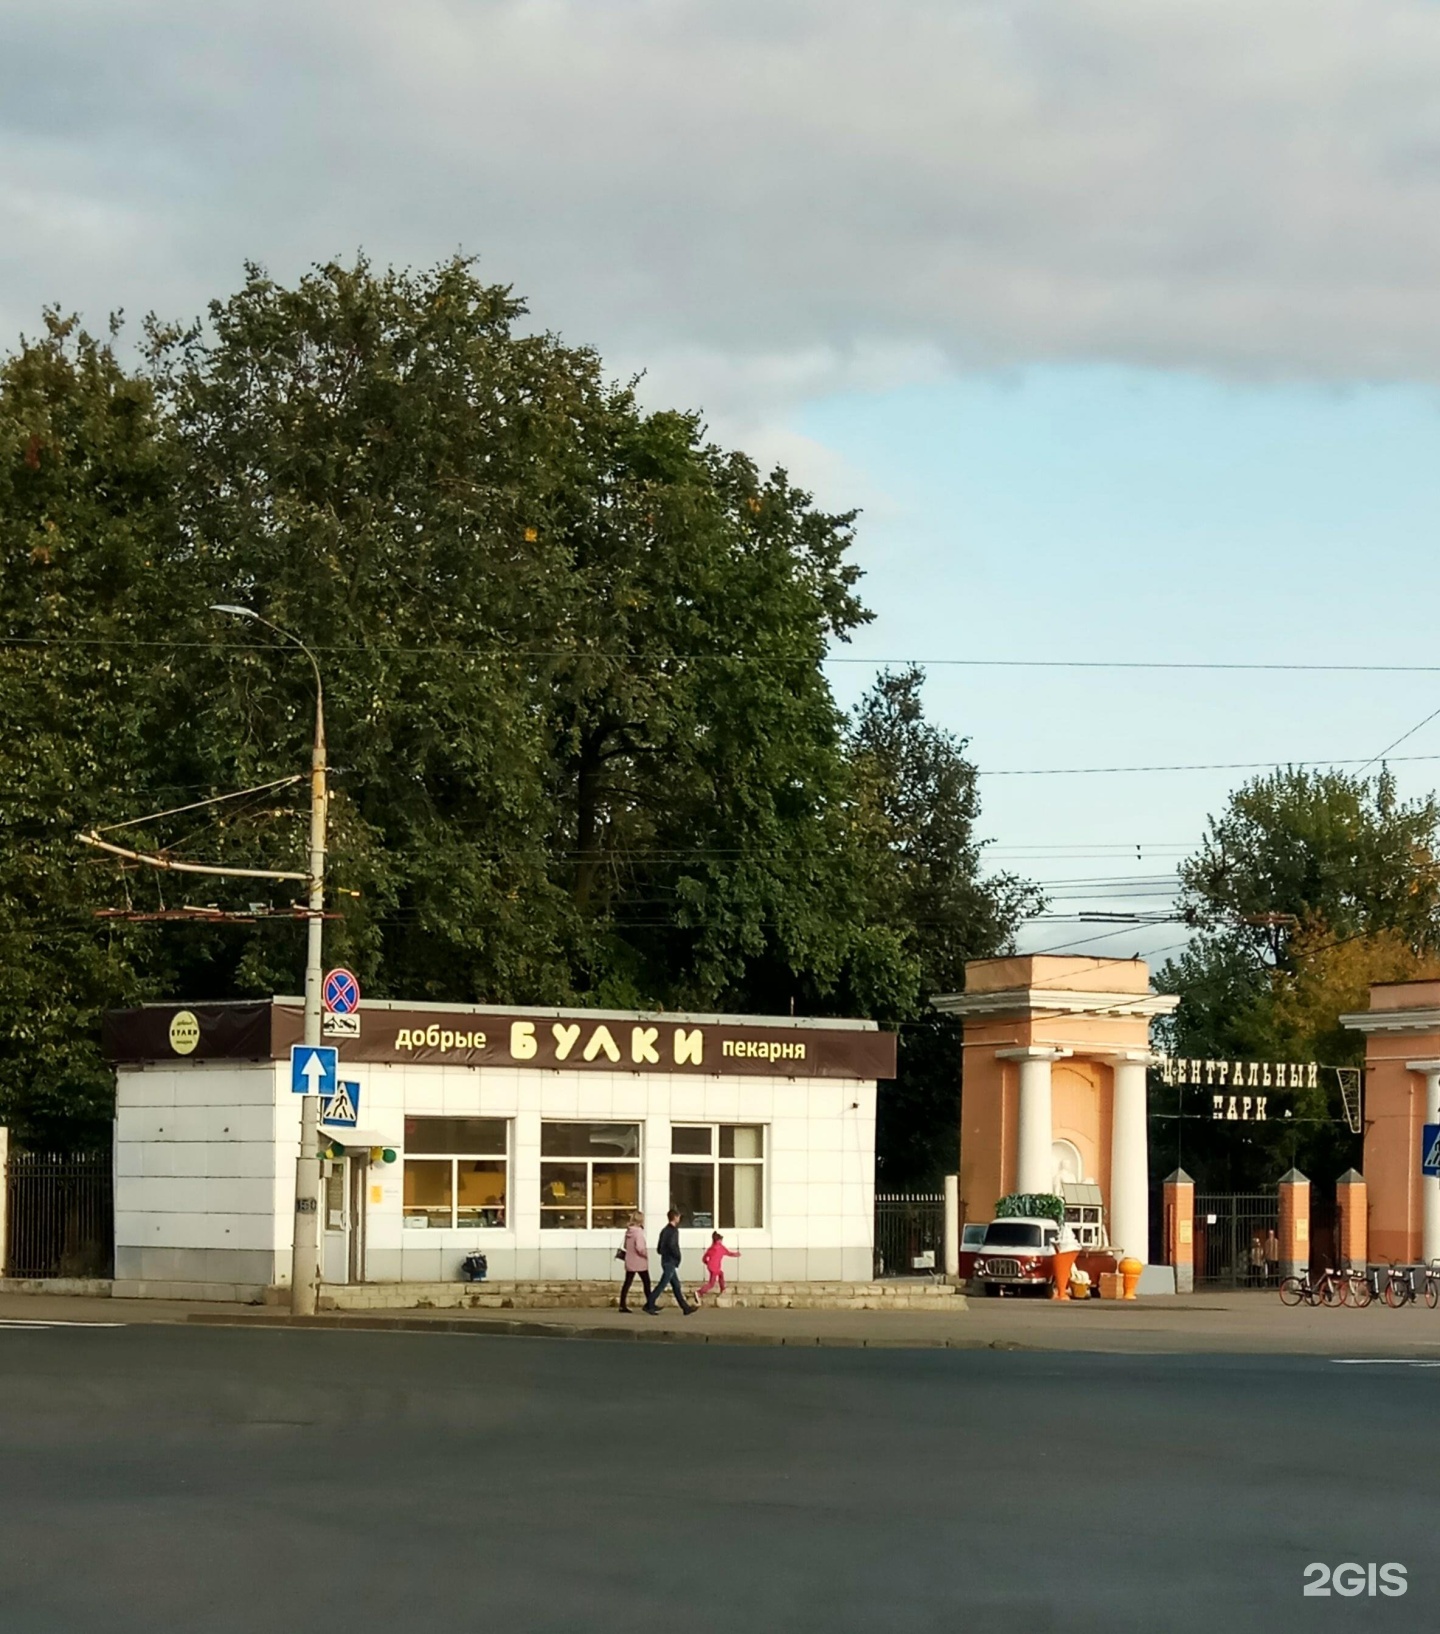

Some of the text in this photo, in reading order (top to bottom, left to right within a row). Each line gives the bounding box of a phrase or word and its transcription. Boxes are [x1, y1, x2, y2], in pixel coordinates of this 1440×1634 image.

[395, 1021, 806, 1065] добрые БУЛКИ пекарня
[1162, 1058, 1317, 1088] ЦЕНТРАЛЬНЫЙ
[1213, 1095, 1267, 1120] ПАРК
